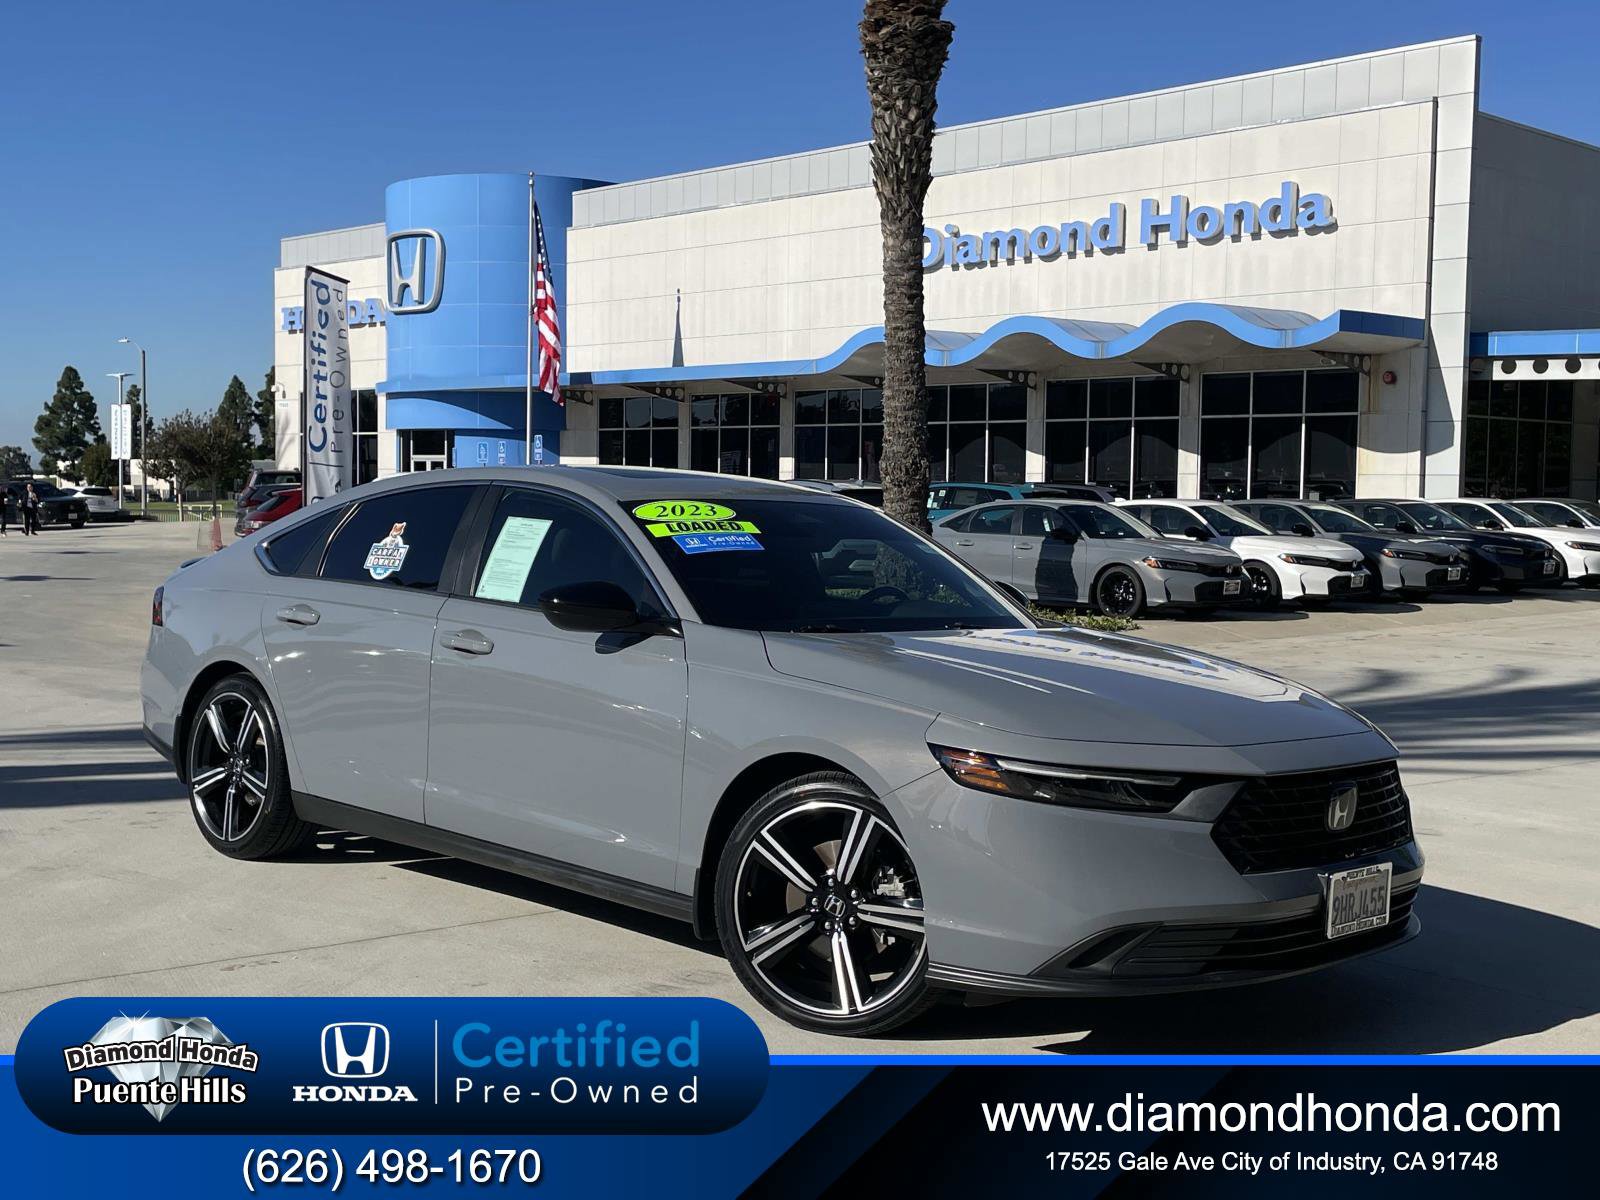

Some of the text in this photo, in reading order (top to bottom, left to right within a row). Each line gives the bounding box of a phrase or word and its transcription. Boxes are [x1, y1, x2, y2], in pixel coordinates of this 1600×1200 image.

[1140, 181, 1335, 245] Honda
[281, 297, 385, 330] HDA
[308, 279, 331, 453] Certified
[330, 288, 348, 453] Pre-Owned
[655, 505, 718, 518] 2023
[666, 521, 744, 533] LOADED
[708, 535, 751, 543] Certified
[1332, 886, 1386, 924] 9HRJ455
